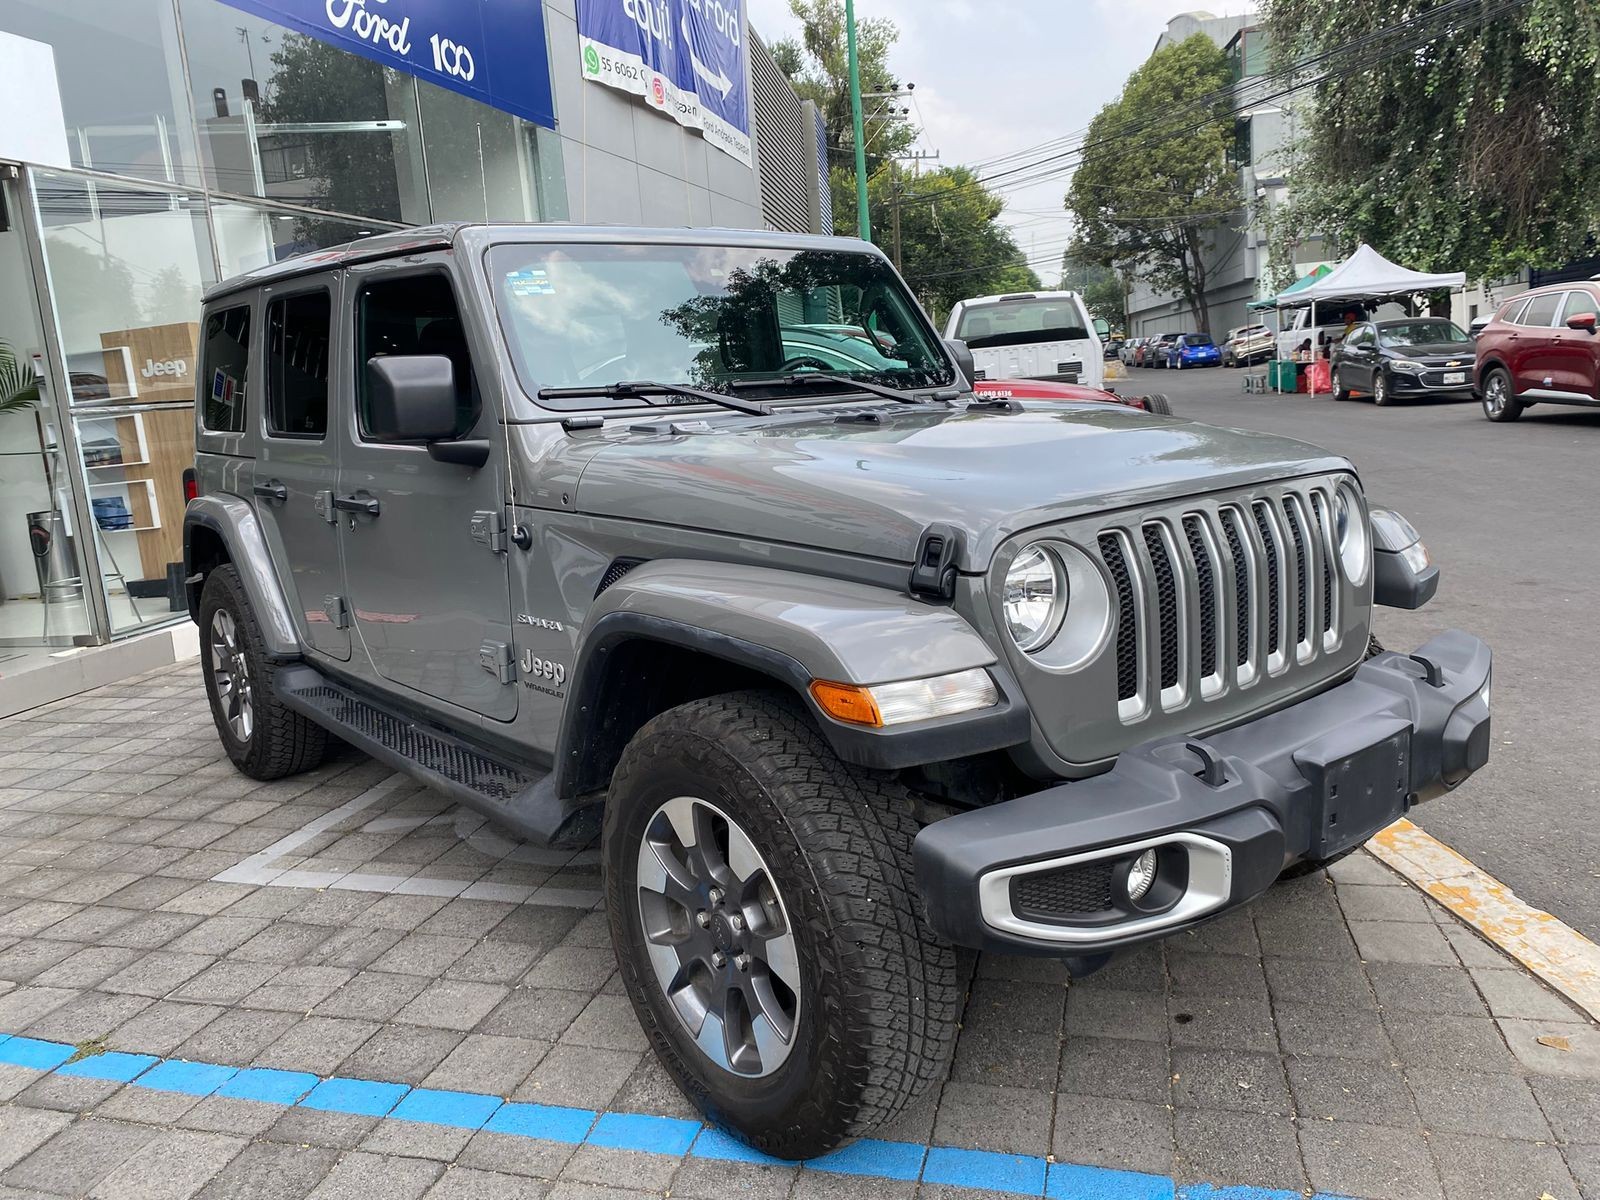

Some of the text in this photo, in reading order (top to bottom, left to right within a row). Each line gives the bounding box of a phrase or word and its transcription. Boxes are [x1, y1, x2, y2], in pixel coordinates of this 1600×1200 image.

[430, 33, 475, 82] 100
[601, 57, 612, 72] 55
[614, 62, 638, 80] 6062
[141, 359, 187, 378] Jeep
[520, 649, 565, 687] Jeep
